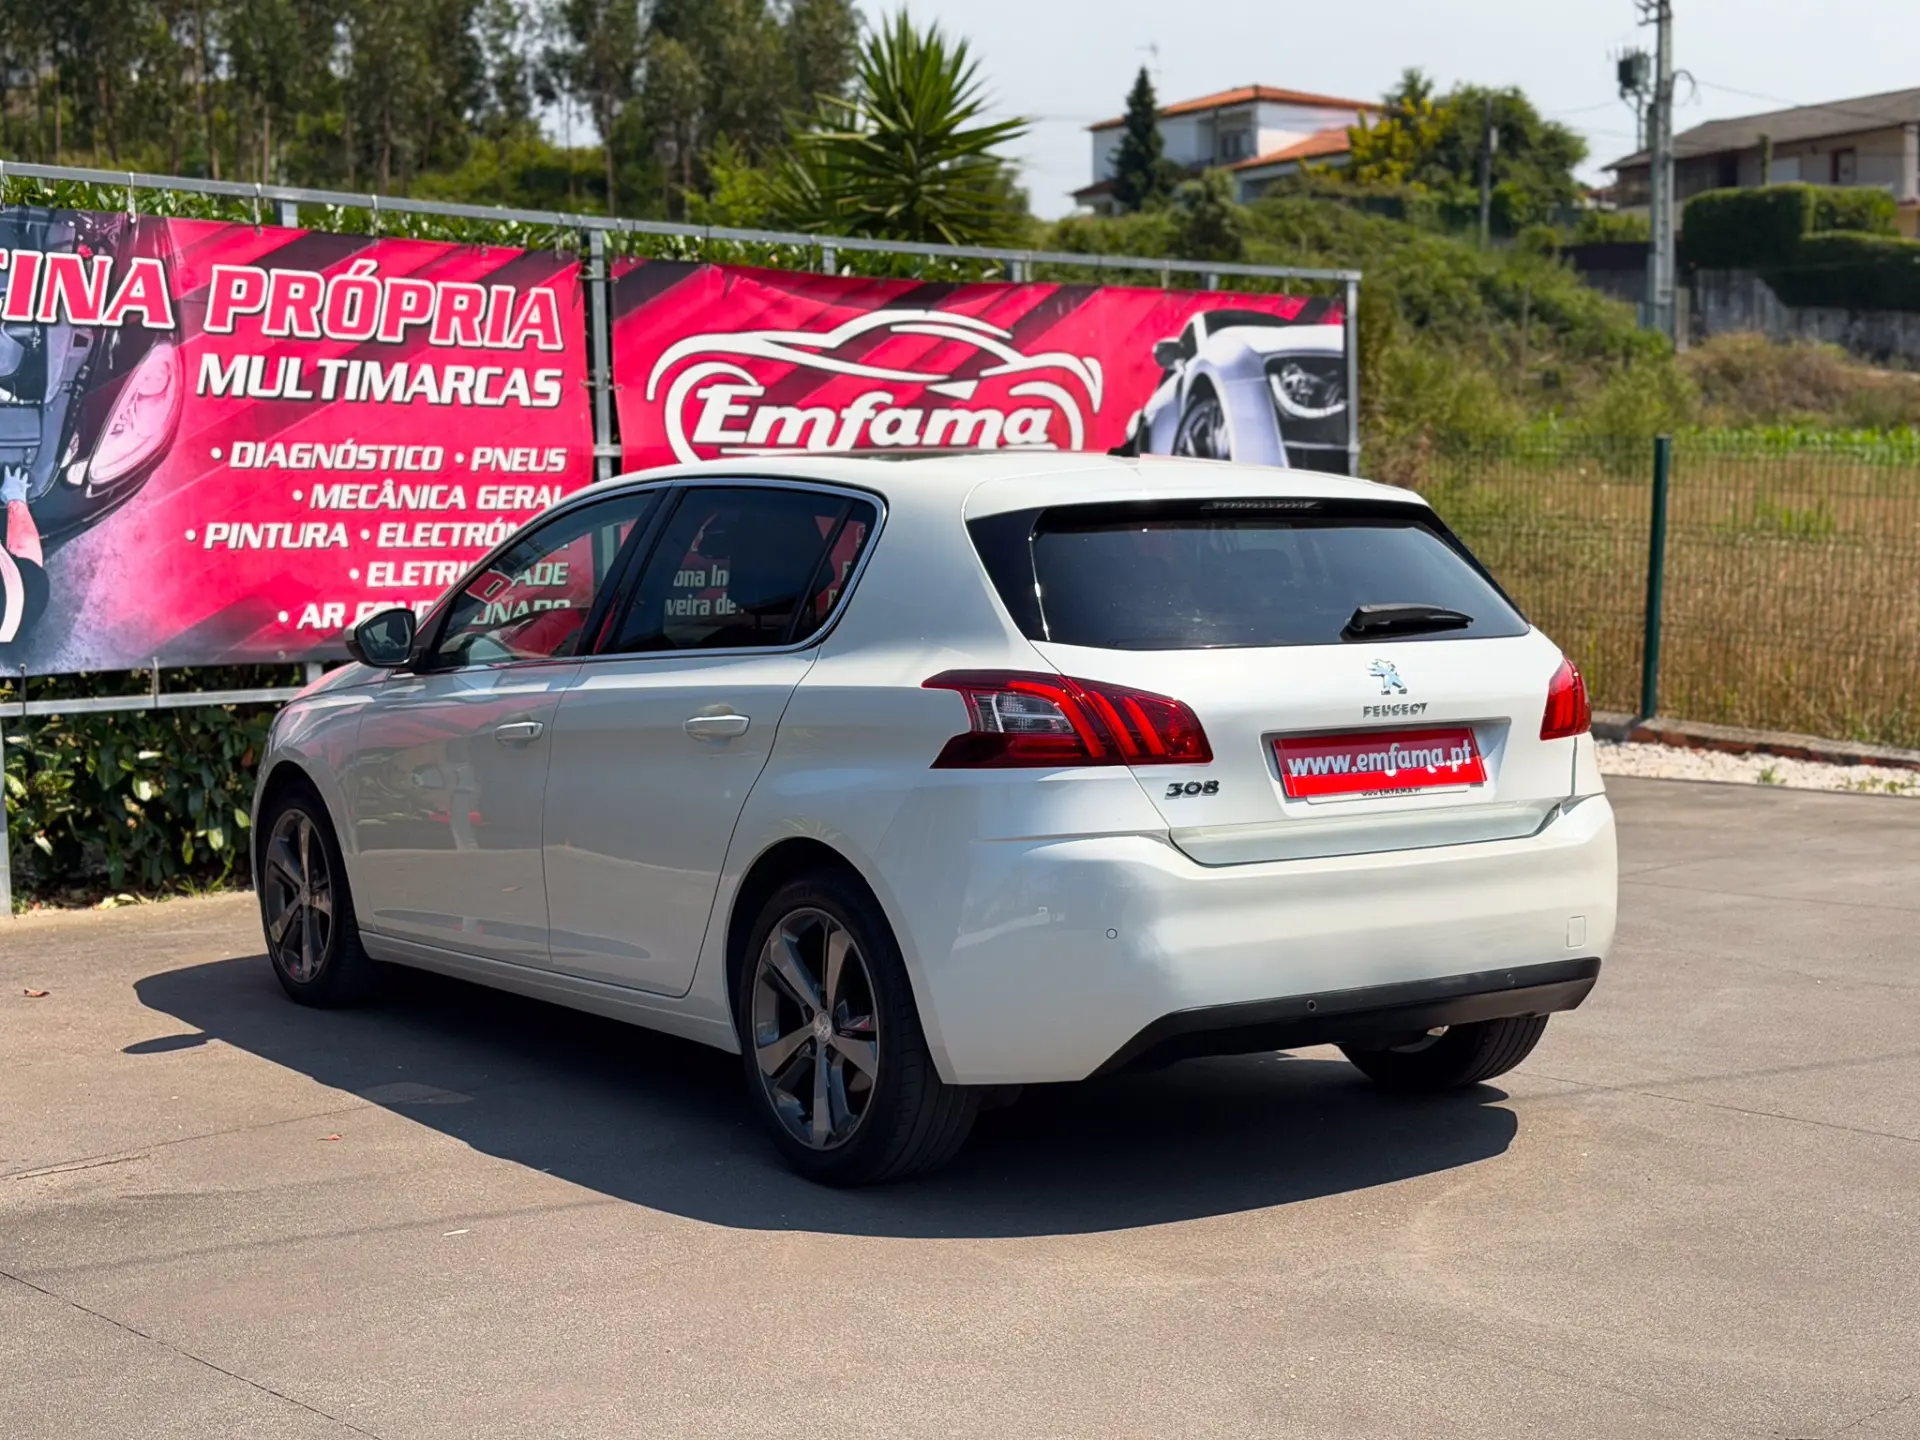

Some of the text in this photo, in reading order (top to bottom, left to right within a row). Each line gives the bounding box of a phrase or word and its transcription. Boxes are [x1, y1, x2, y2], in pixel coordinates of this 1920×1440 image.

[0, 248, 563, 350] INA PRÓPRIA
[197, 353, 563, 408] MULTIMARCAS
[692, 385, 1055, 450] Emfama
[229, 439, 567, 472] DIAGNÓSTICO PNEUS
[309, 479, 467, 510] MECÂNICA
[203, 521, 349, 549] PINTURA
[297, 602, 346, 630] AR
[665, 593, 711, 616] veira
[1362, 702, 1428, 718] PEUGEOT
[1287, 738, 1472, 777] www.emfama.pt
[1164, 779, 1220, 800] 308
